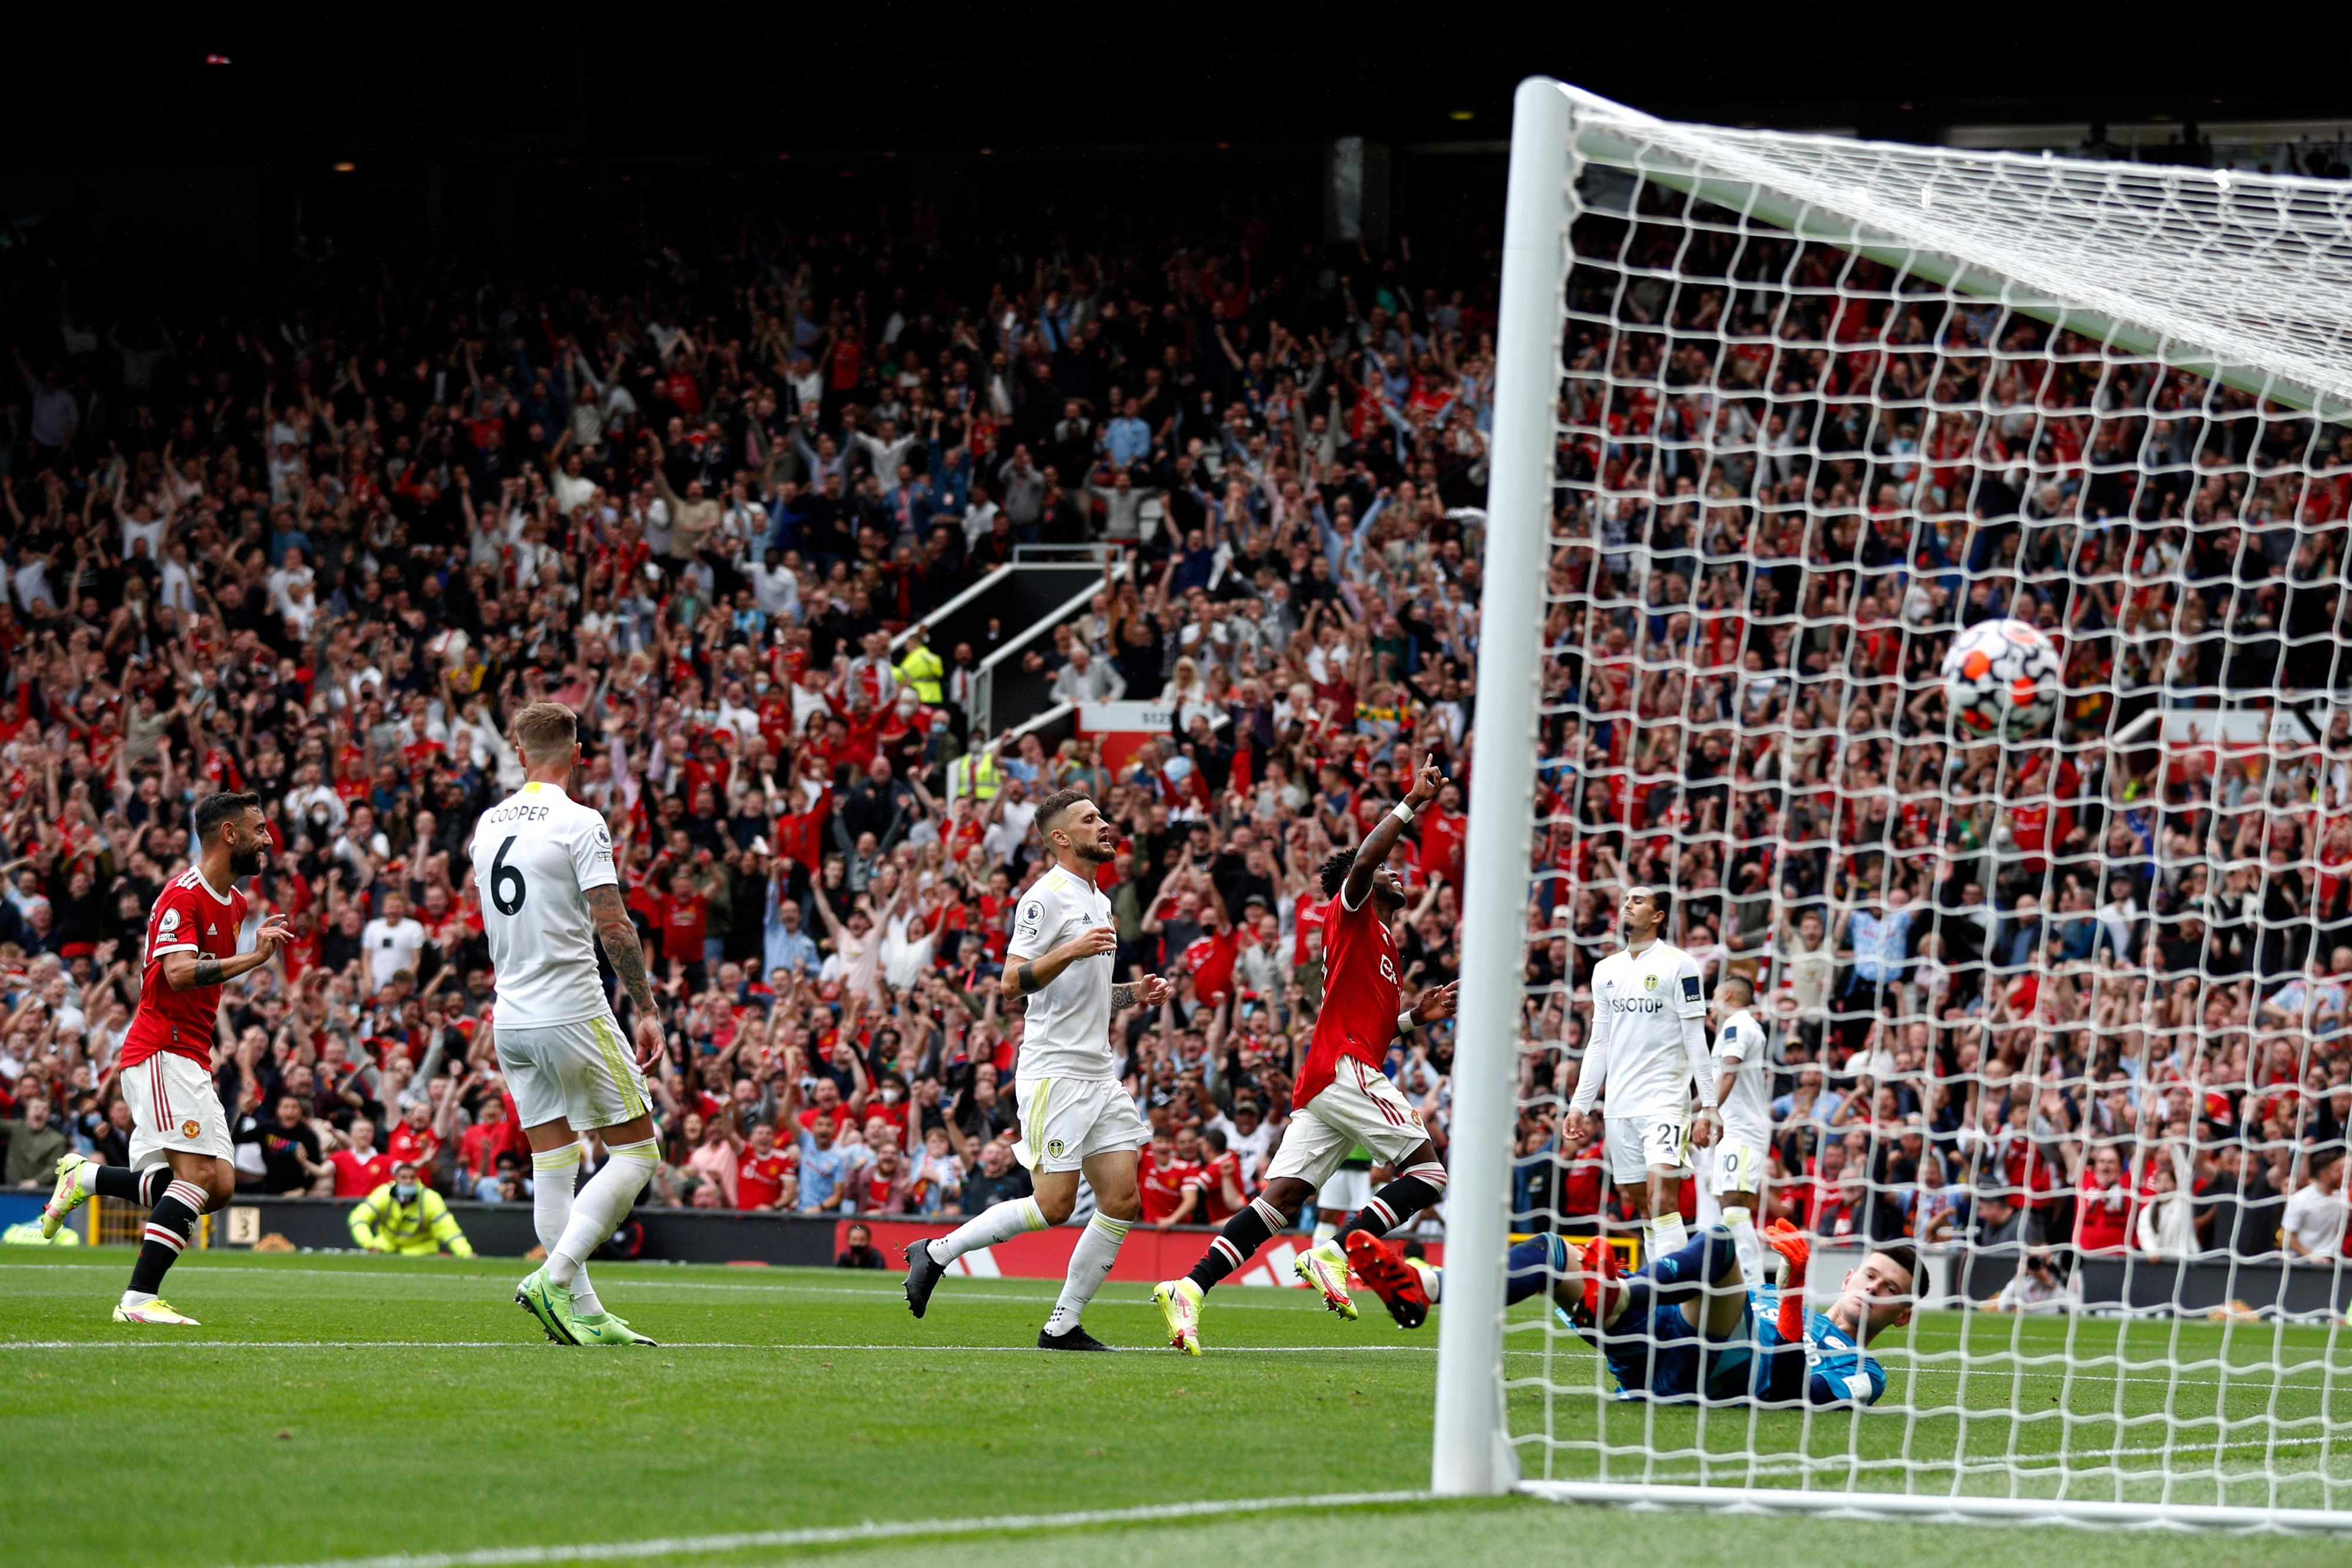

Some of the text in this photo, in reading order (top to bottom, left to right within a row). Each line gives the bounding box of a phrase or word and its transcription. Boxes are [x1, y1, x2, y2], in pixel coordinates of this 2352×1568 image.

[490, 806, 549, 824] COOPER
[490, 835, 526, 917] 6
[1022, 926, 1035, 934] room
[1612, 998, 1663, 1013] SBOTOP
[1656, 1123, 1680, 1147] 21
[239, 1217, 249, 1238] 3
